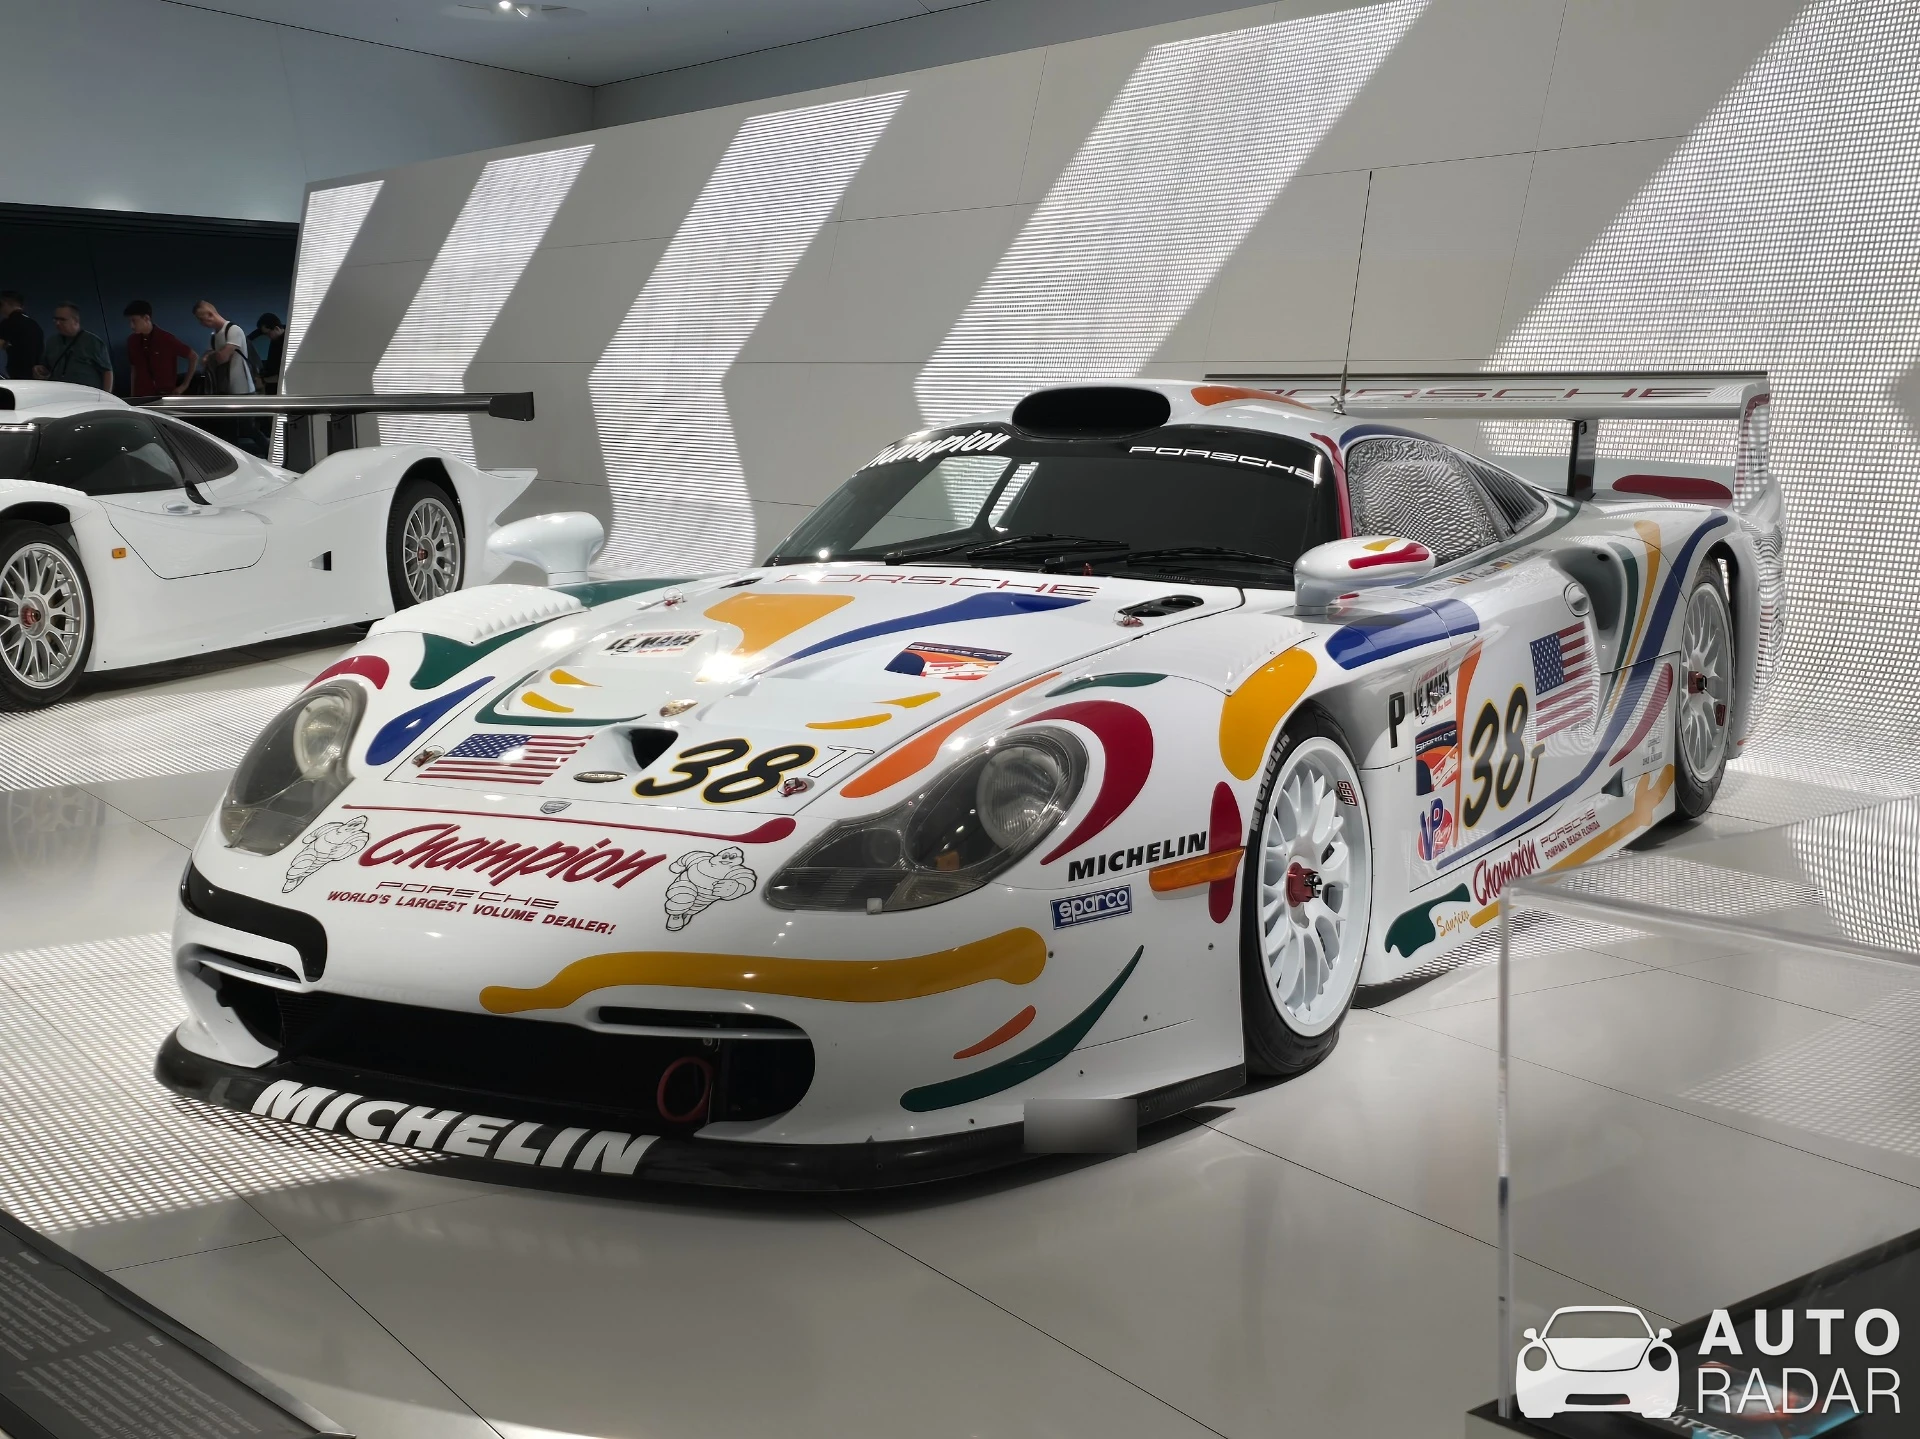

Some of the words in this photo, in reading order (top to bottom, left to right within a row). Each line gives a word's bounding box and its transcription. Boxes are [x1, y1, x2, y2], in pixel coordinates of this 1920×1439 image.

[855, 430, 1012, 477] hampion
[1129, 446, 1322, 486] PORSCHE
[776, 574, 1101, 597] PORSCHE
[632, 634, 702, 649] MANS
[1388, 691, 1406, 749] P
[1250, 733, 1291, 832] MICHELIN
[1419, 797, 1444, 861] VP
[1540, 808, 1596, 848] PORSCHE
[357, 823, 669, 890] Champion
[1067, 830, 1207, 882] MICHELIN
[327, 890, 390, 905] WORLD'S
[395, 896, 468, 914] LARGEST
[472, 904, 539, 923] VOLUME
[541, 914, 617, 936] DEALER!
[375, 881, 560, 910] PORSCHE
[1058, 889, 1129, 923] sparco
[251, 1078, 661, 1176] MICHELIN
